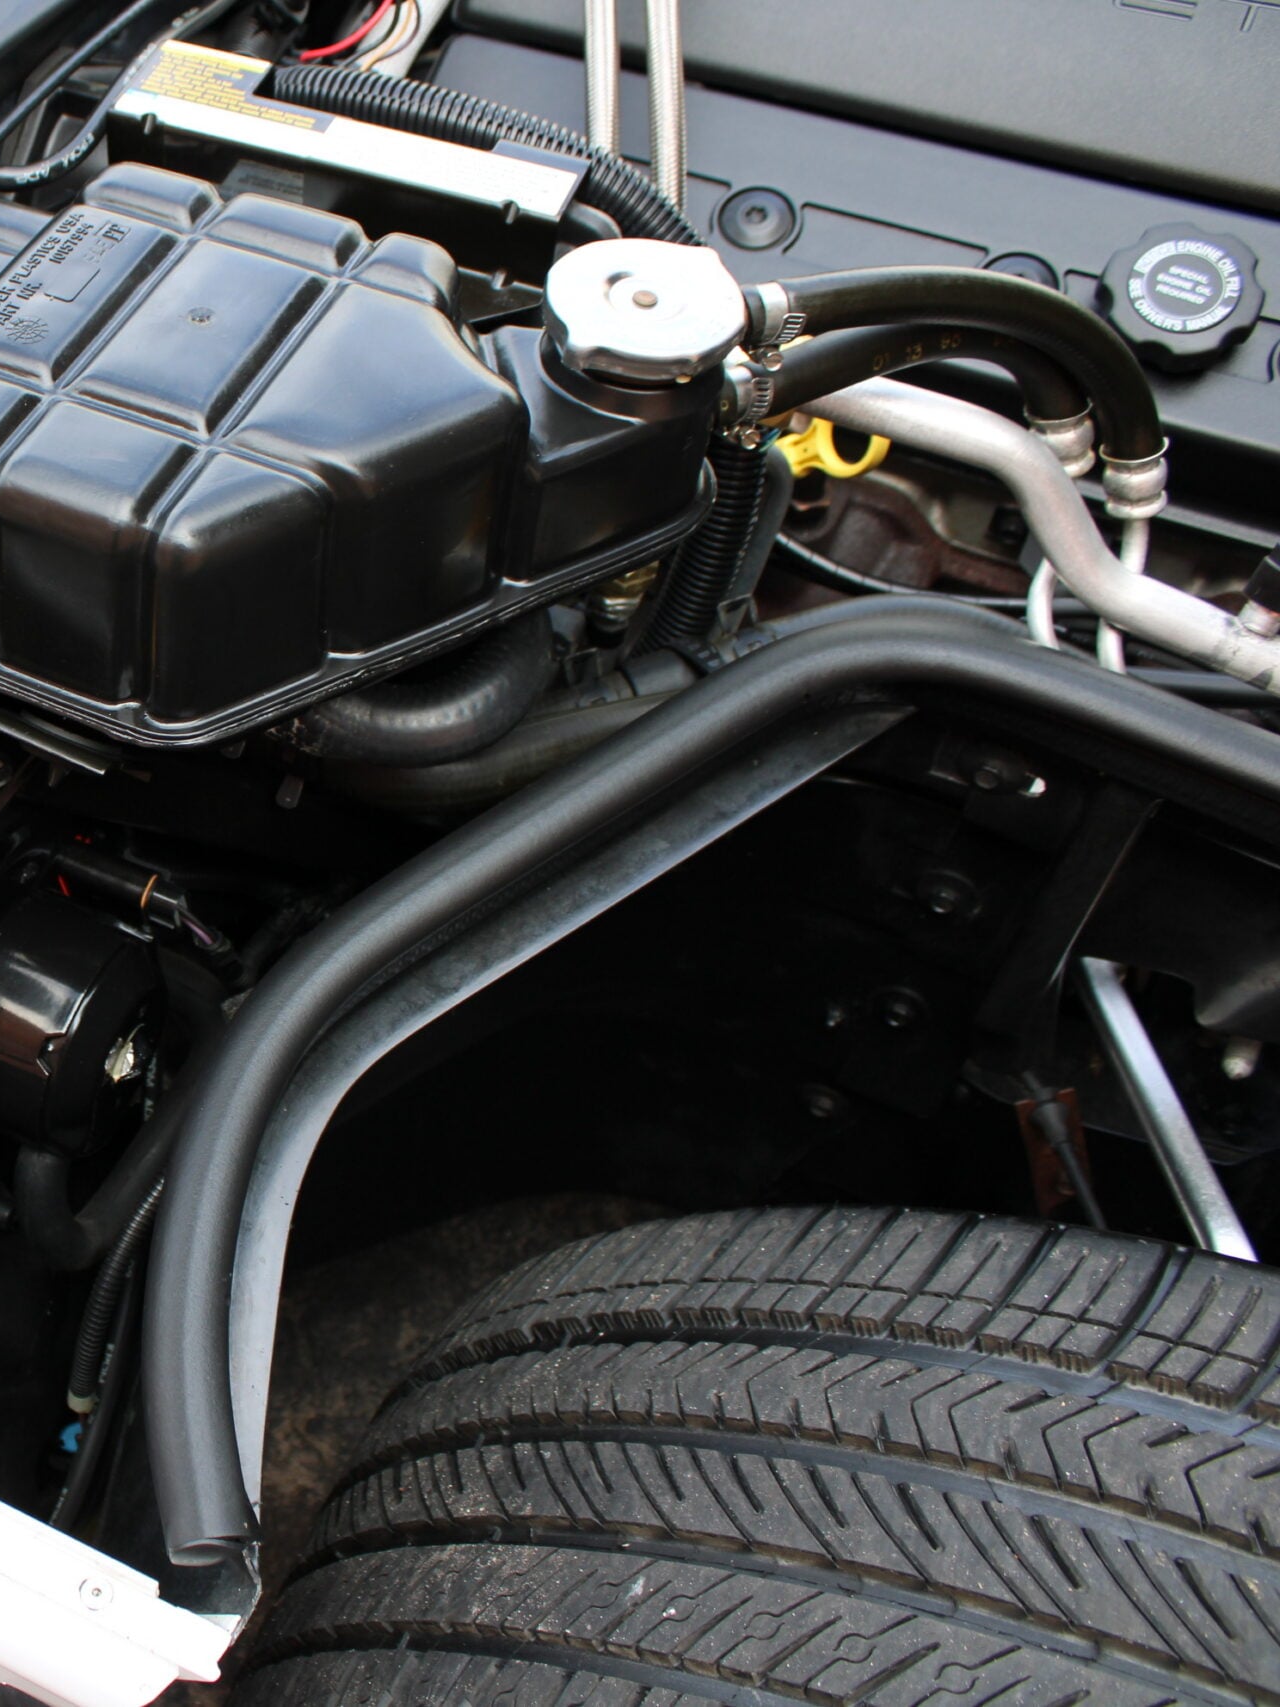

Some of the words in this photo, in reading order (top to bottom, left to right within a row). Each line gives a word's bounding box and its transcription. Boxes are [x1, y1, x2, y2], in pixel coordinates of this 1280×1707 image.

[8, 234, 61, 284] PLASTICS
[55, 210, 84, 234] USA
[1178, 240, 1223, 261] ENGINE
[1169, 265, 1209, 284] SPECIAL
[1220, 255, 1237, 277] OIL
[1128, 278, 1142, 299] SEE
[1155, 284, 1206, 305] REQUIRED
[1157, 273, 1193, 290] ENGINE
[1195, 285, 1213, 297] OIL
[1224, 275, 1241, 298] FILL
[1134, 299, 1184, 331] OWNER'S
